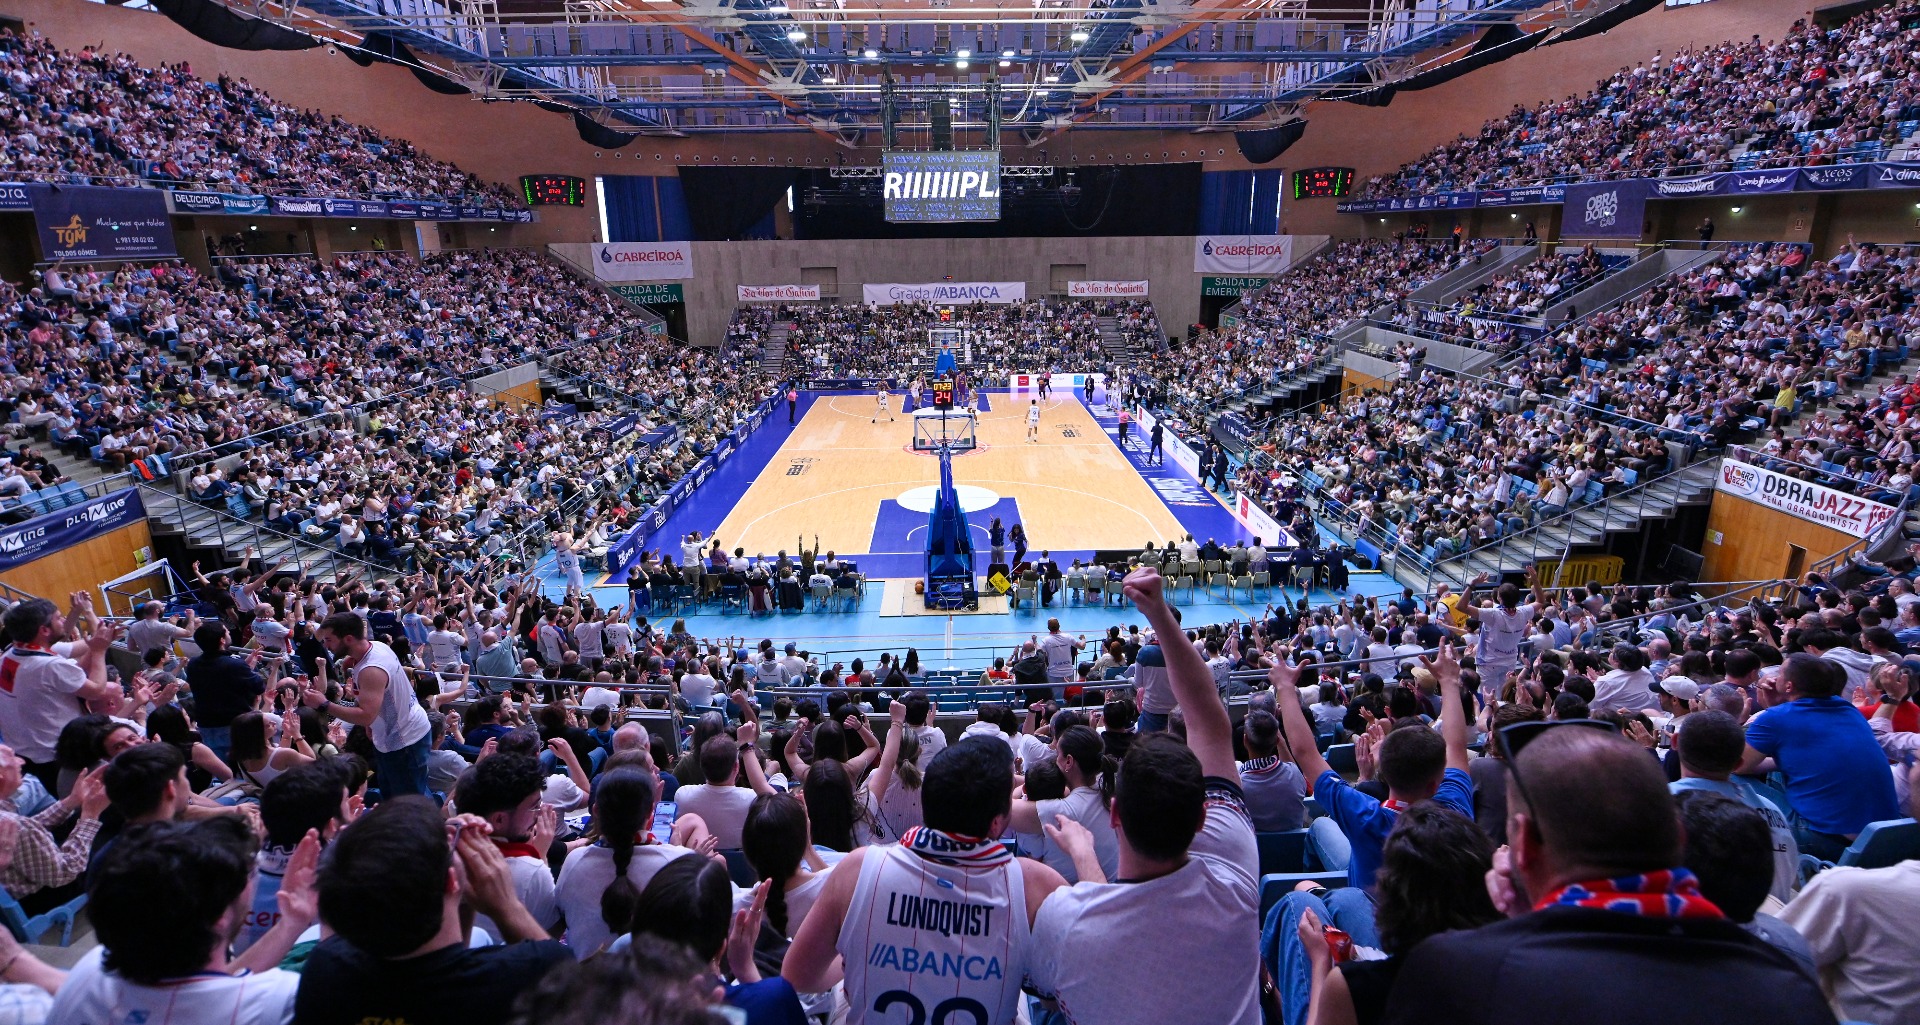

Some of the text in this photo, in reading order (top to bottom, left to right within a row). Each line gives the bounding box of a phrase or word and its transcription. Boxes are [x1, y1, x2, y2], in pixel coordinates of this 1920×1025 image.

[1587, 190, 1618, 211] OBRA
[1585, 204, 1618, 222] DOIRO
[96, 217, 117, 226] Mucho
[134, 221, 145, 230] que
[146, 218, 165, 226] toldos
[1600, 215, 1615, 227] CAB
[615, 249, 683, 262] CABREIROÁ
[1071, 282, 1143, 294] La Voz de Galicia
[1215, 277, 1261, 287] SAIDA DE
[621, 285, 668, 295] SAIDA DE
[742, 287, 756, 298] La
[775, 287, 784, 297] de
[786, 286, 816, 298] Galicia
[889, 287, 930, 300] Grada
[624, 294, 679, 304] ERXENCIA
[933, 383, 951, 391] 07:23
[936, 391, 951, 404] 24
[1787, 502, 1859, 532] OBRADOIRISTA
[887, 892, 994, 937] LUNDQVIST
